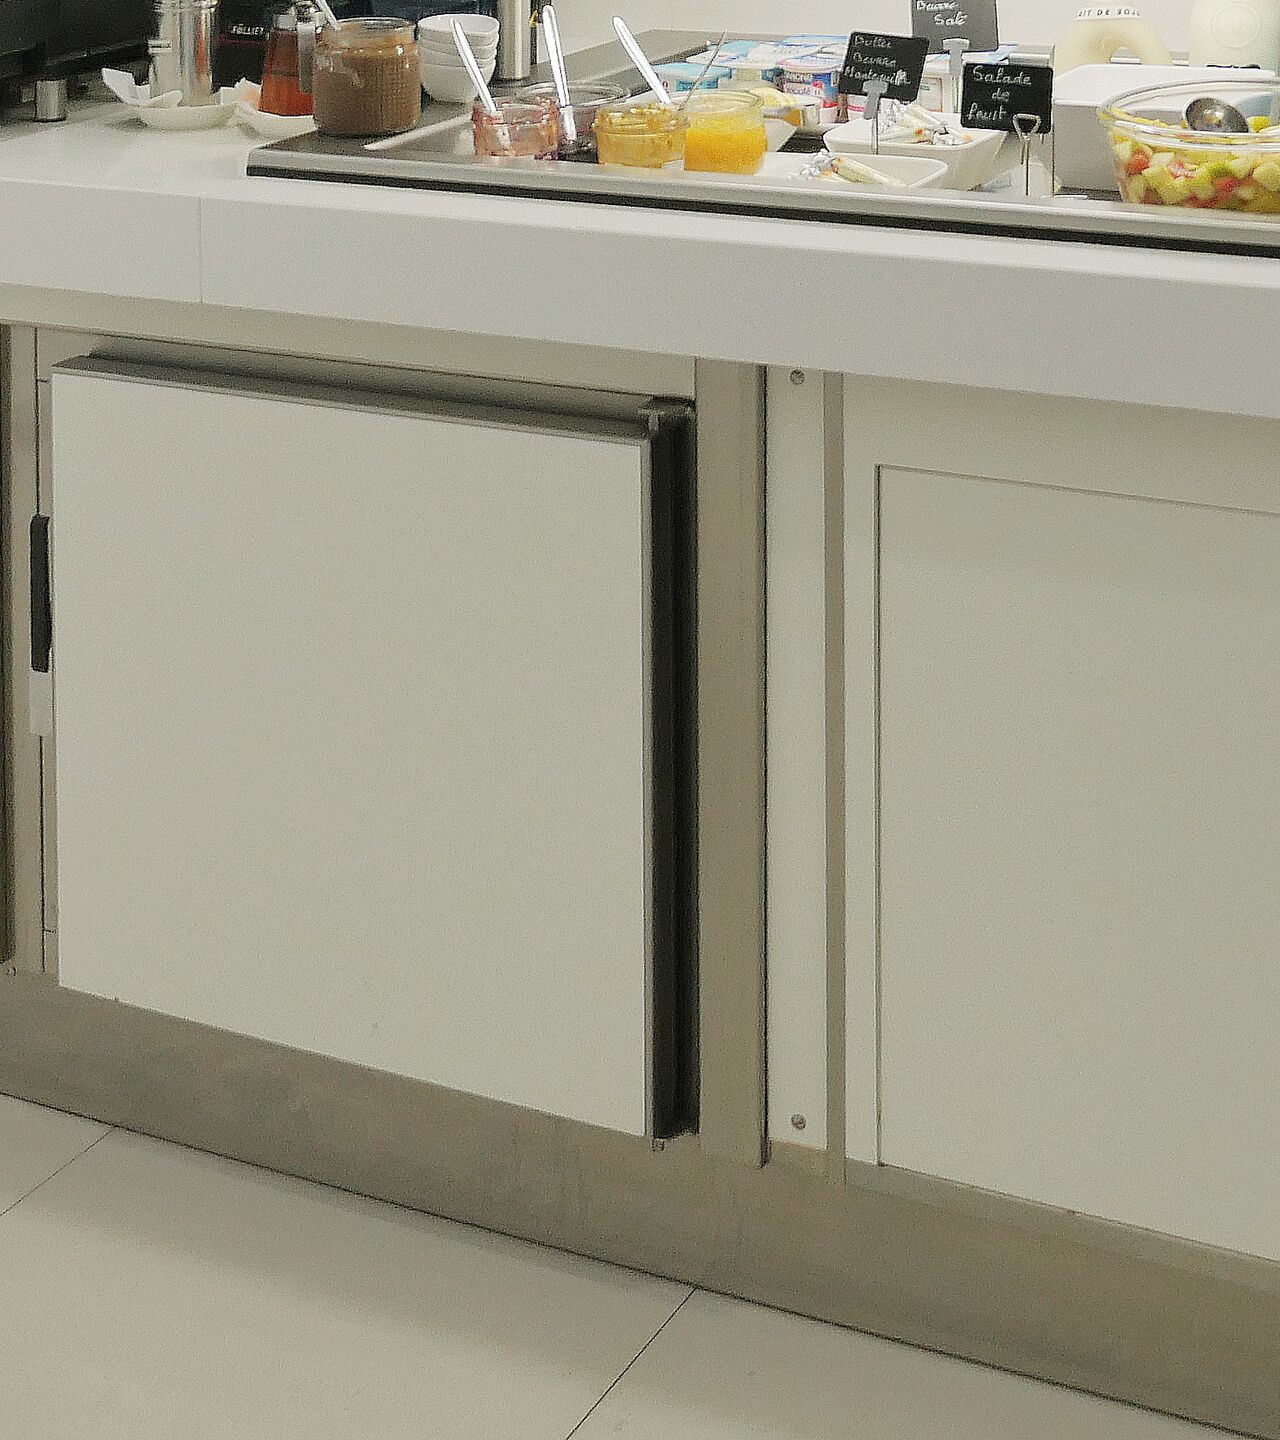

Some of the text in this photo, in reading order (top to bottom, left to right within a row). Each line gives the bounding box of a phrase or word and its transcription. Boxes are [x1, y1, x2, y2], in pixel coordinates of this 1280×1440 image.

[1096, 8, 1111, 16] DE
[972, 65, 1032, 85] Salade
[991, 87, 1010, 102] de
